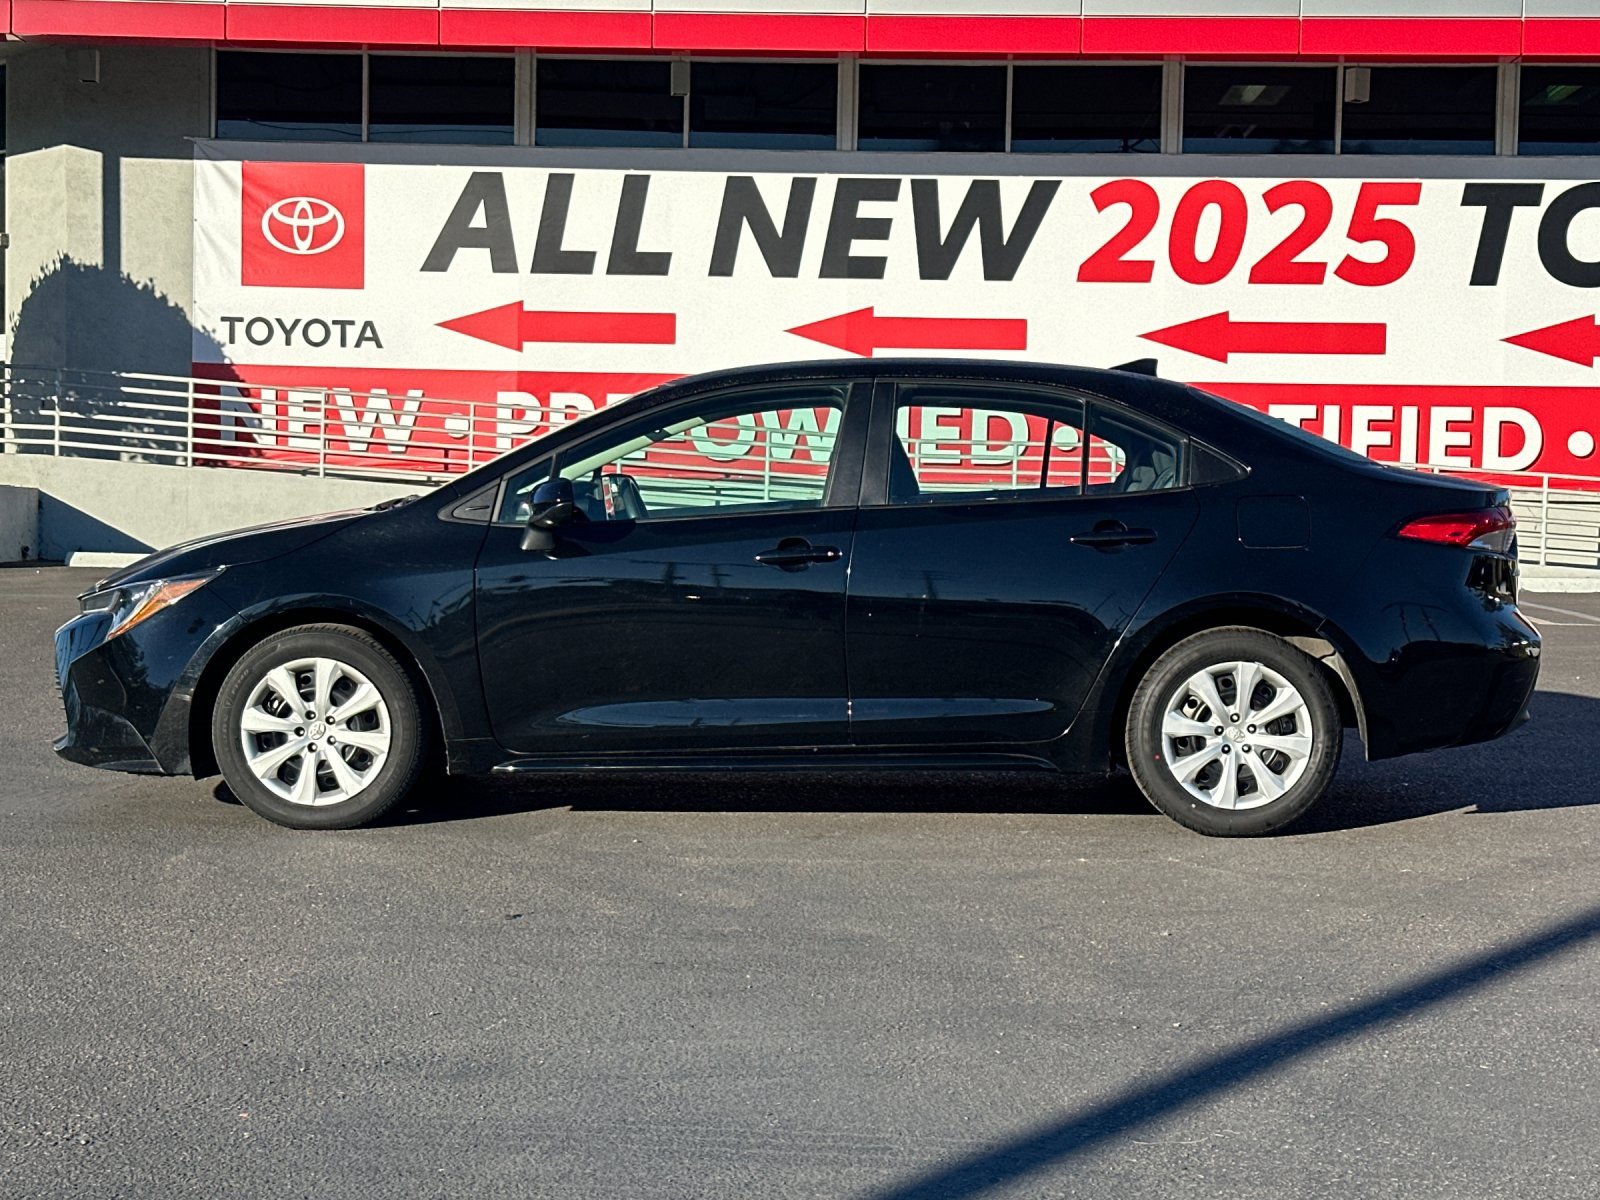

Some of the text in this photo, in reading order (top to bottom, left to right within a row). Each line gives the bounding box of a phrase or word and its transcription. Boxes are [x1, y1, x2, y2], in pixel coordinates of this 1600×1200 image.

[420, 171, 673, 276] ALL
[708, 175, 1063, 281] NEW
[1076, 178, 1423, 287] 2025
[220, 316, 384, 349] TOYOTA
[219, 386, 424, 452] NEW
